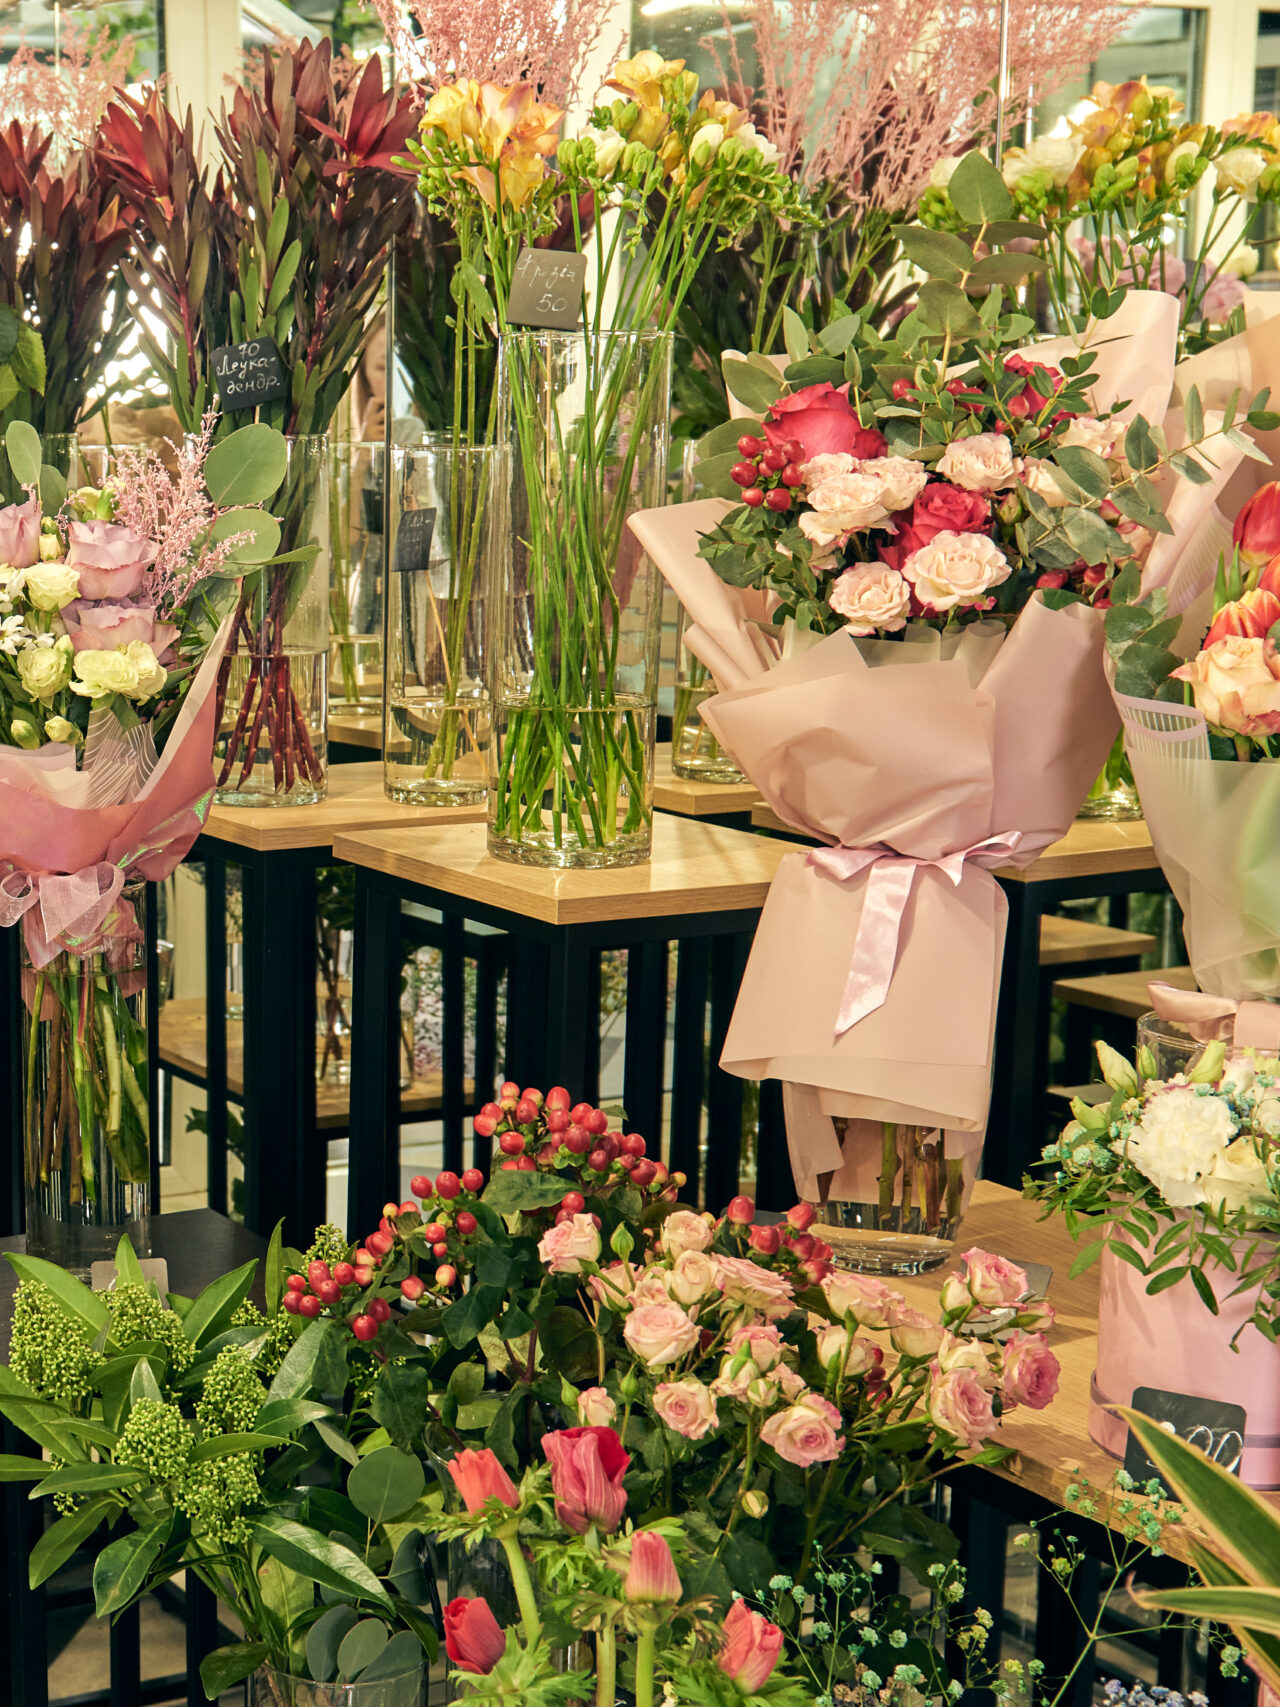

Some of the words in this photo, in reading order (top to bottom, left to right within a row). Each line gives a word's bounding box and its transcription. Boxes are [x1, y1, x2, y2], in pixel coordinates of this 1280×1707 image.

[536, 293, 568, 312] 50
[238, 342, 260, 360] 70
[1146, 1421, 1243, 1473] 00
